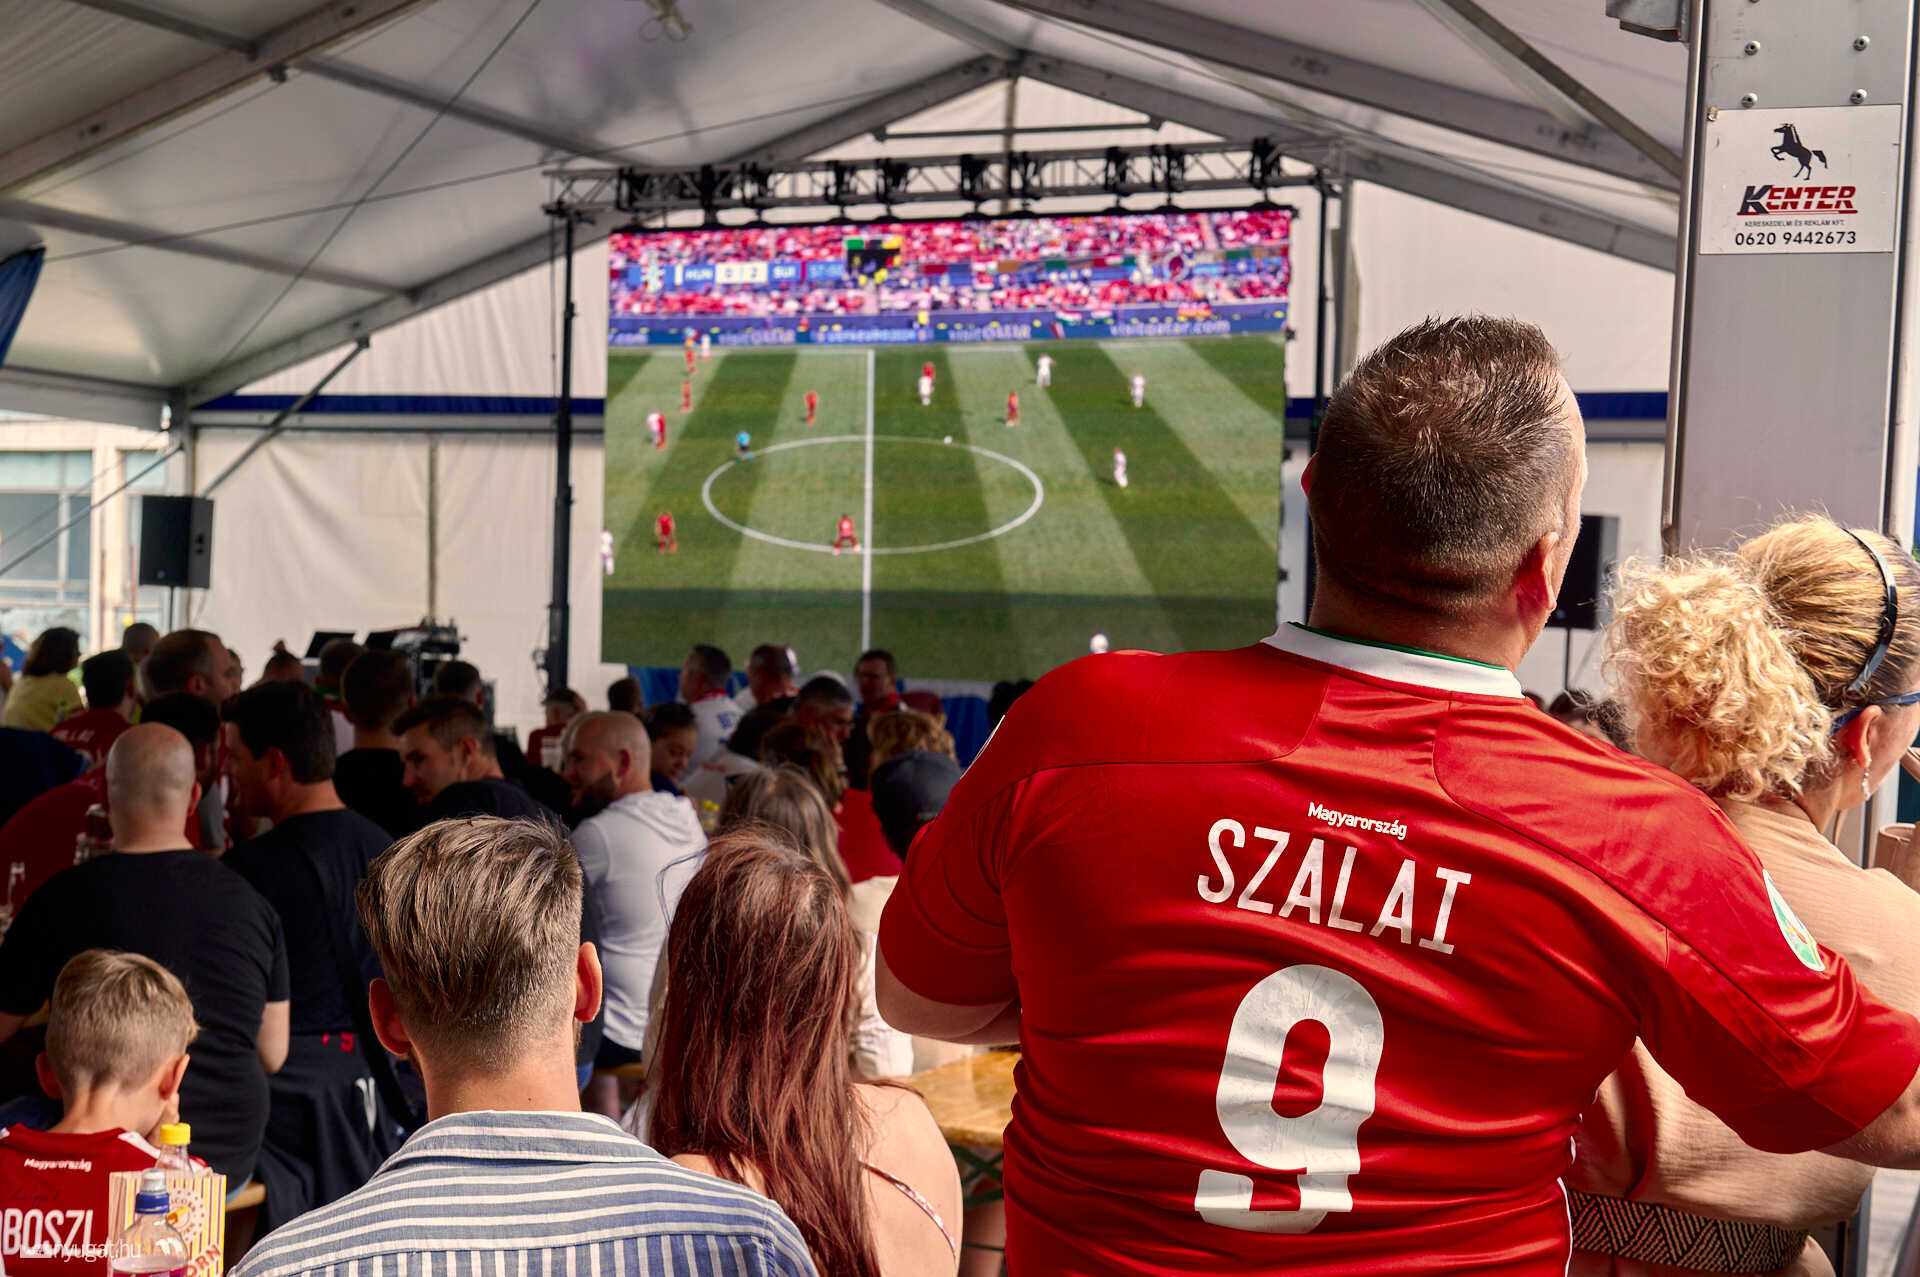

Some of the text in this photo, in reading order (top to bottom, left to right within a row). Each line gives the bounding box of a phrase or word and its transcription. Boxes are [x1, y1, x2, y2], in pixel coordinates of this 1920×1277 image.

[1738, 184, 1857, 215] KENTER
[1735, 231, 1857, 246] 0620 9442673
[1307, 801, 1408, 841] Magyarország
[1197, 817, 1473, 955] SZALAI
[1194, 963, 1385, 1235] 9
[23, 1158, 92, 1173] Magyarország
